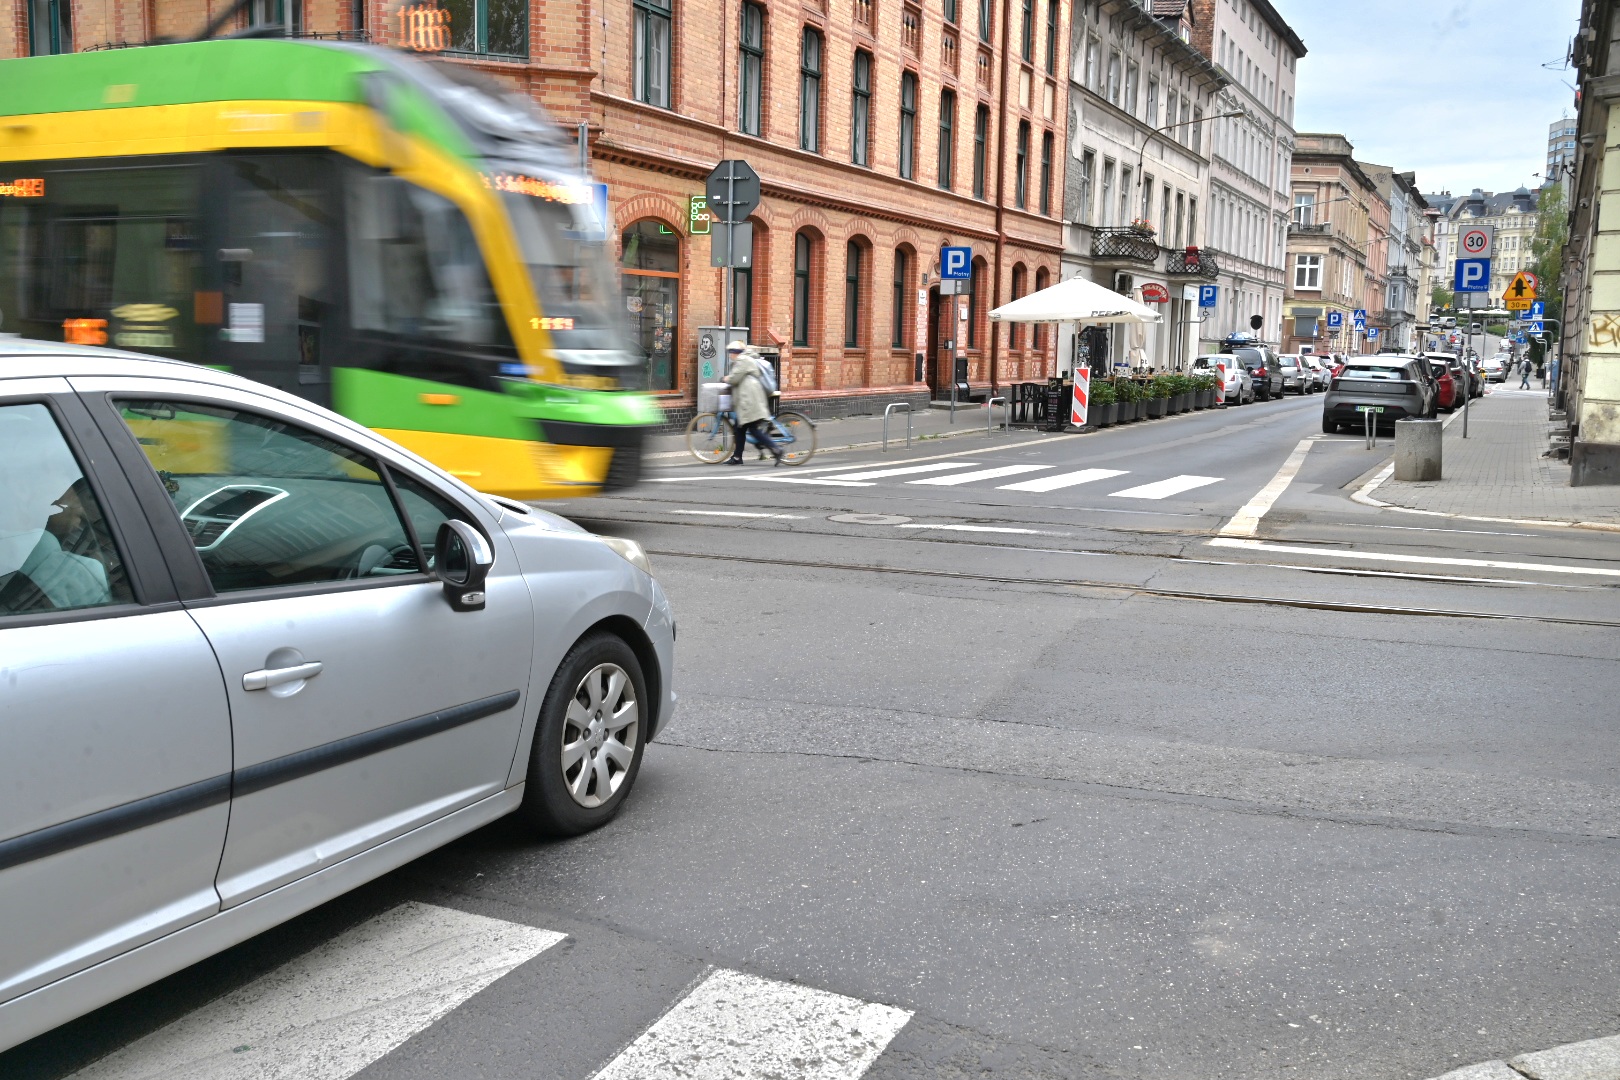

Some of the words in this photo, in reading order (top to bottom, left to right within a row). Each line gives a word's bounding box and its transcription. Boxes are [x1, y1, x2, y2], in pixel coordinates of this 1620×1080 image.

[1467, 237, 1484, 247] 30
[948, 250, 965, 275] P
[1462, 262, 1483, 288] P
[1203, 287, 1213, 301] P
[1330, 314, 1339, 325] P
[1369, 328, 1376, 337] P
